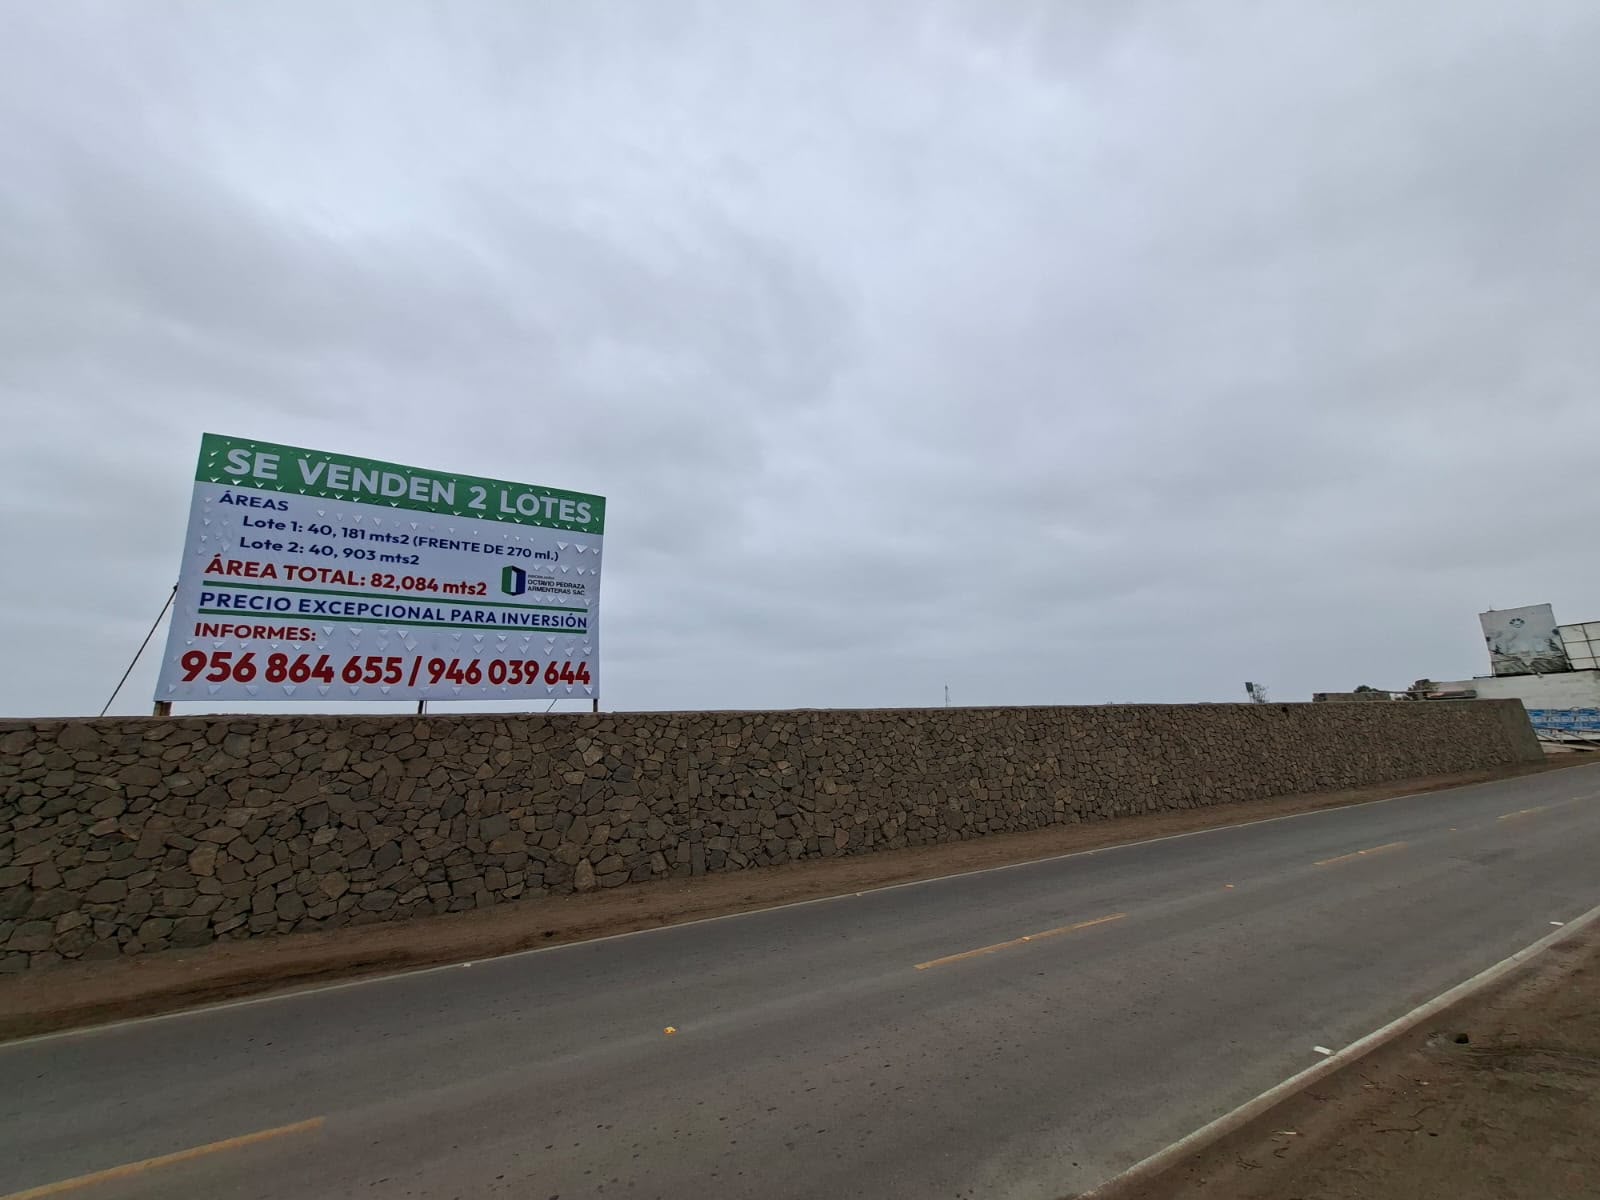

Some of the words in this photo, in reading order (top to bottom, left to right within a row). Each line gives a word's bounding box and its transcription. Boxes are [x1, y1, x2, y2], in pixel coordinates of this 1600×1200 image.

[219, 490, 289, 511] ÁREAS
[223, 448, 281, 480] SE
[297, 458, 455, 506] VENDEN
[468, 486, 487, 510] 2
[500, 490, 592, 524] LOTES
[239, 536, 283, 552] Lote
[287, 542, 304, 553] 2:
[308, 544, 338, 559] 40,
[342, 547, 376, 561] 903
[379, 553, 420, 566] mts2
[243, 515, 286, 531] Lote
[290, 521, 303, 532] 1:
[307, 523, 337, 538] 40,
[341, 527, 366, 540] 181
[369, 533, 410, 545] mts2
[413, 535, 481, 553] (FRENTE
[483, 543, 505, 555] DE
[507, 547, 532, 558] 270
[534, 549, 560, 562] ml.)
[204, 553, 278, 580] ÁREA
[283, 565, 366, 587] TOTAL:
[370, 572, 439, 592] 82,084
[442, 581, 488, 596] mts2
[527, 579, 555, 587] OCTAVIO
[556, 582, 586, 590] PEDRAZA
[527, 586, 572, 595] ARMENTERAS
[200, 592, 292, 612] PRECIO
[298, 599, 445, 622] EXCEPCIONAL
[451, 608, 497, 624] PARA
[501, 612, 588, 629] INVERSIÓN
[194, 622, 317, 642] INFORMES:
[180, 650, 257, 683] 956
[264, 652, 335, 684] 864
[341, 655, 403, 686] 655
[427, 657, 482, 686] 946
[488, 659, 540, 686] 039
[543, 660, 591, 686] 644
